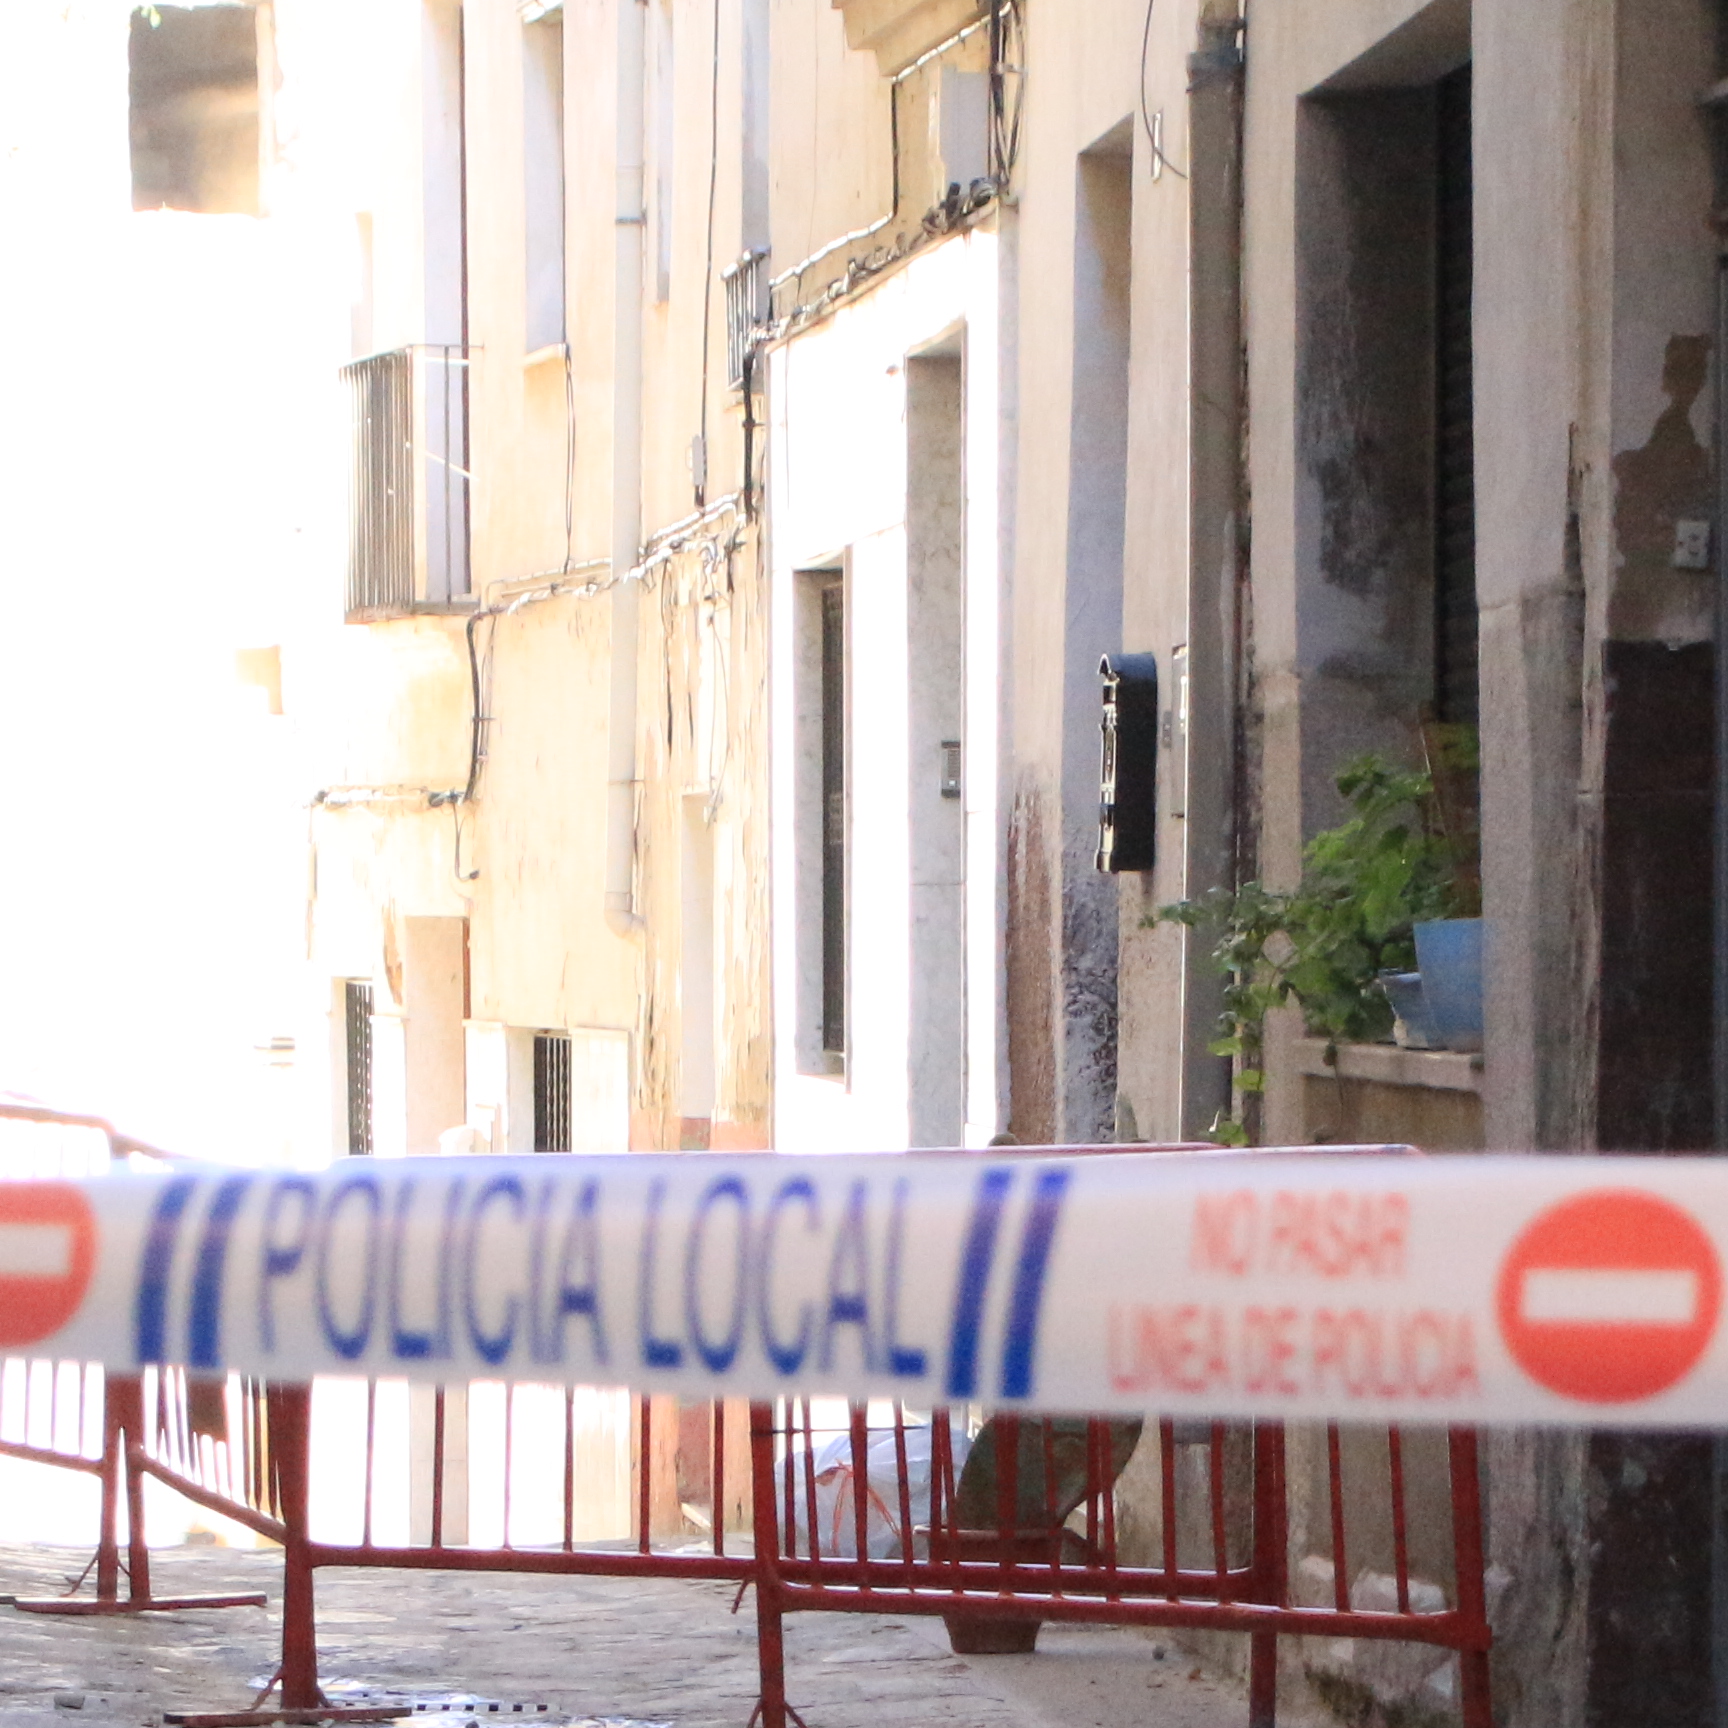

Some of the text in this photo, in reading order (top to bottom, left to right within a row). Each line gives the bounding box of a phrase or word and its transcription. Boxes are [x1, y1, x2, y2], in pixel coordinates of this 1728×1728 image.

[258, 1172, 927, 1379] POLICIA LOCAL
[1189, 1188, 1410, 1280] NO PASAR
[1107, 1302, 1482, 1400] LINEA DE POLICIA
